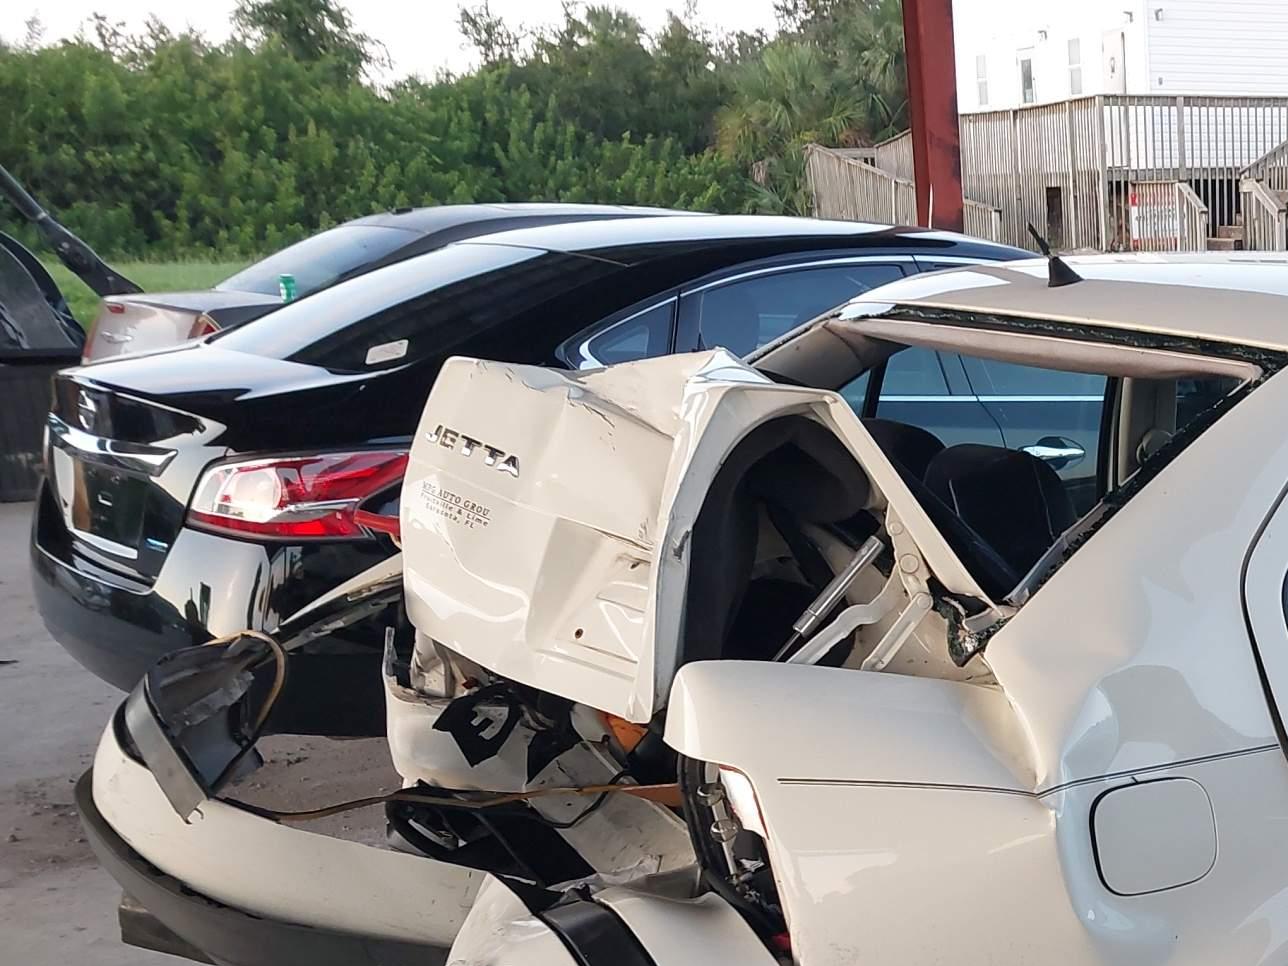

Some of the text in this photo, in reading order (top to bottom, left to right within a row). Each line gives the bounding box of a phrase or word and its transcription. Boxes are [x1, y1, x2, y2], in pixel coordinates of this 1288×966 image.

[425, 424, 520, 478] JETTA
[438, 489, 462, 504] AUTO
[464, 519, 475, 529] FL
